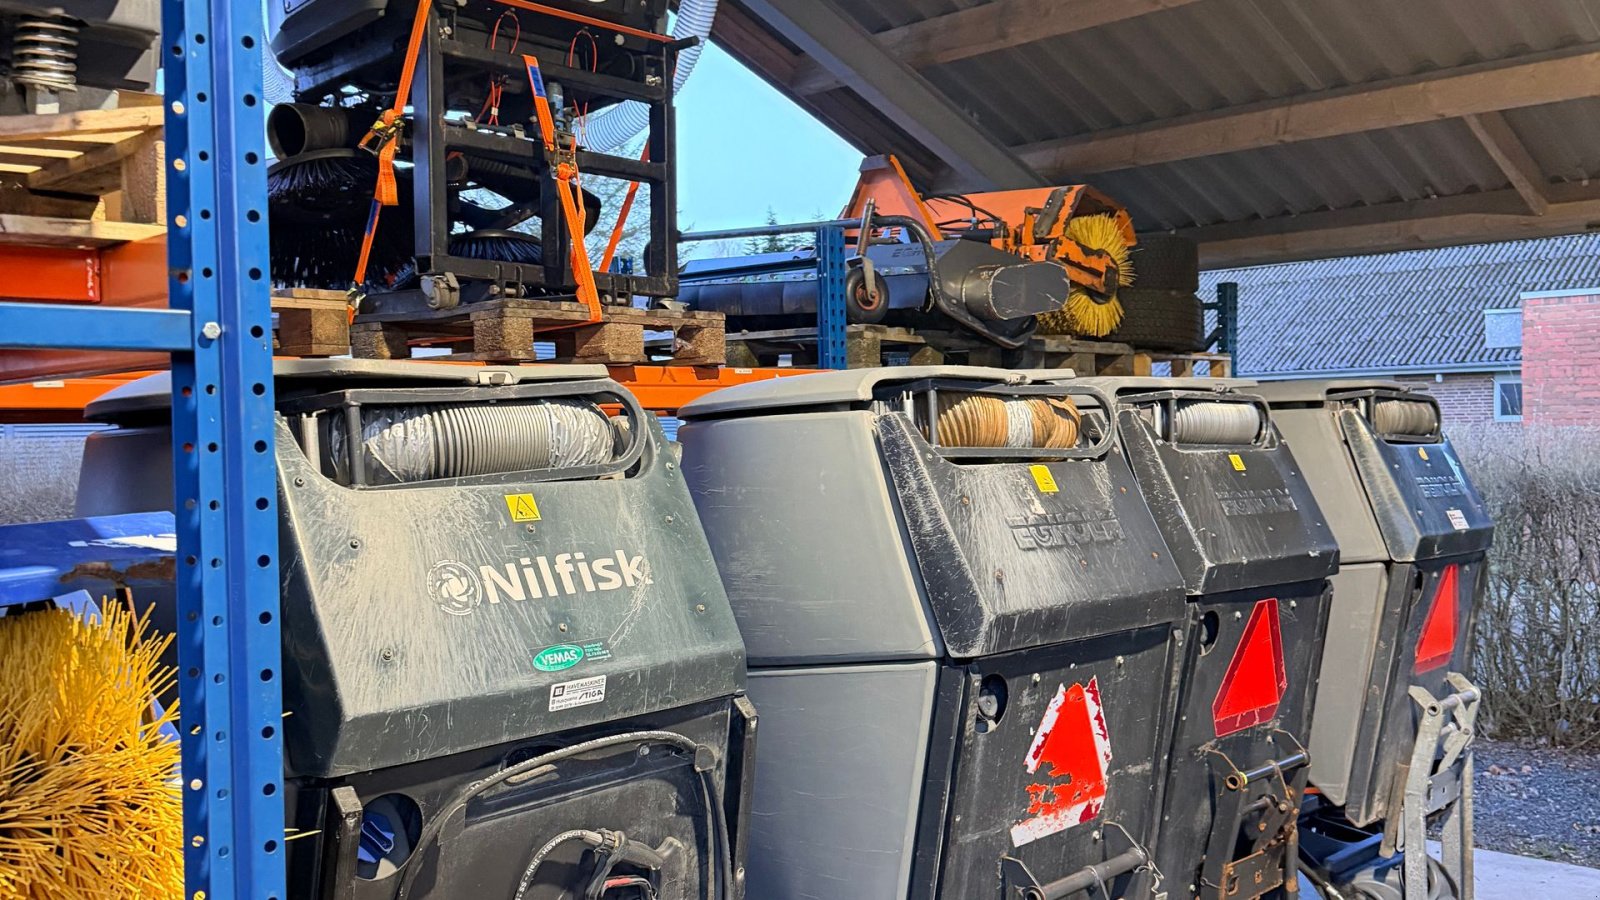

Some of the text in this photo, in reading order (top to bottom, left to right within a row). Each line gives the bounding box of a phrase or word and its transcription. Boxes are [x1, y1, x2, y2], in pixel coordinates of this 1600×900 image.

[479, 550, 654, 604] Nilfisk
[542, 649, 578, 665] VEMAS
[526, 858, 540, 876] Italy
